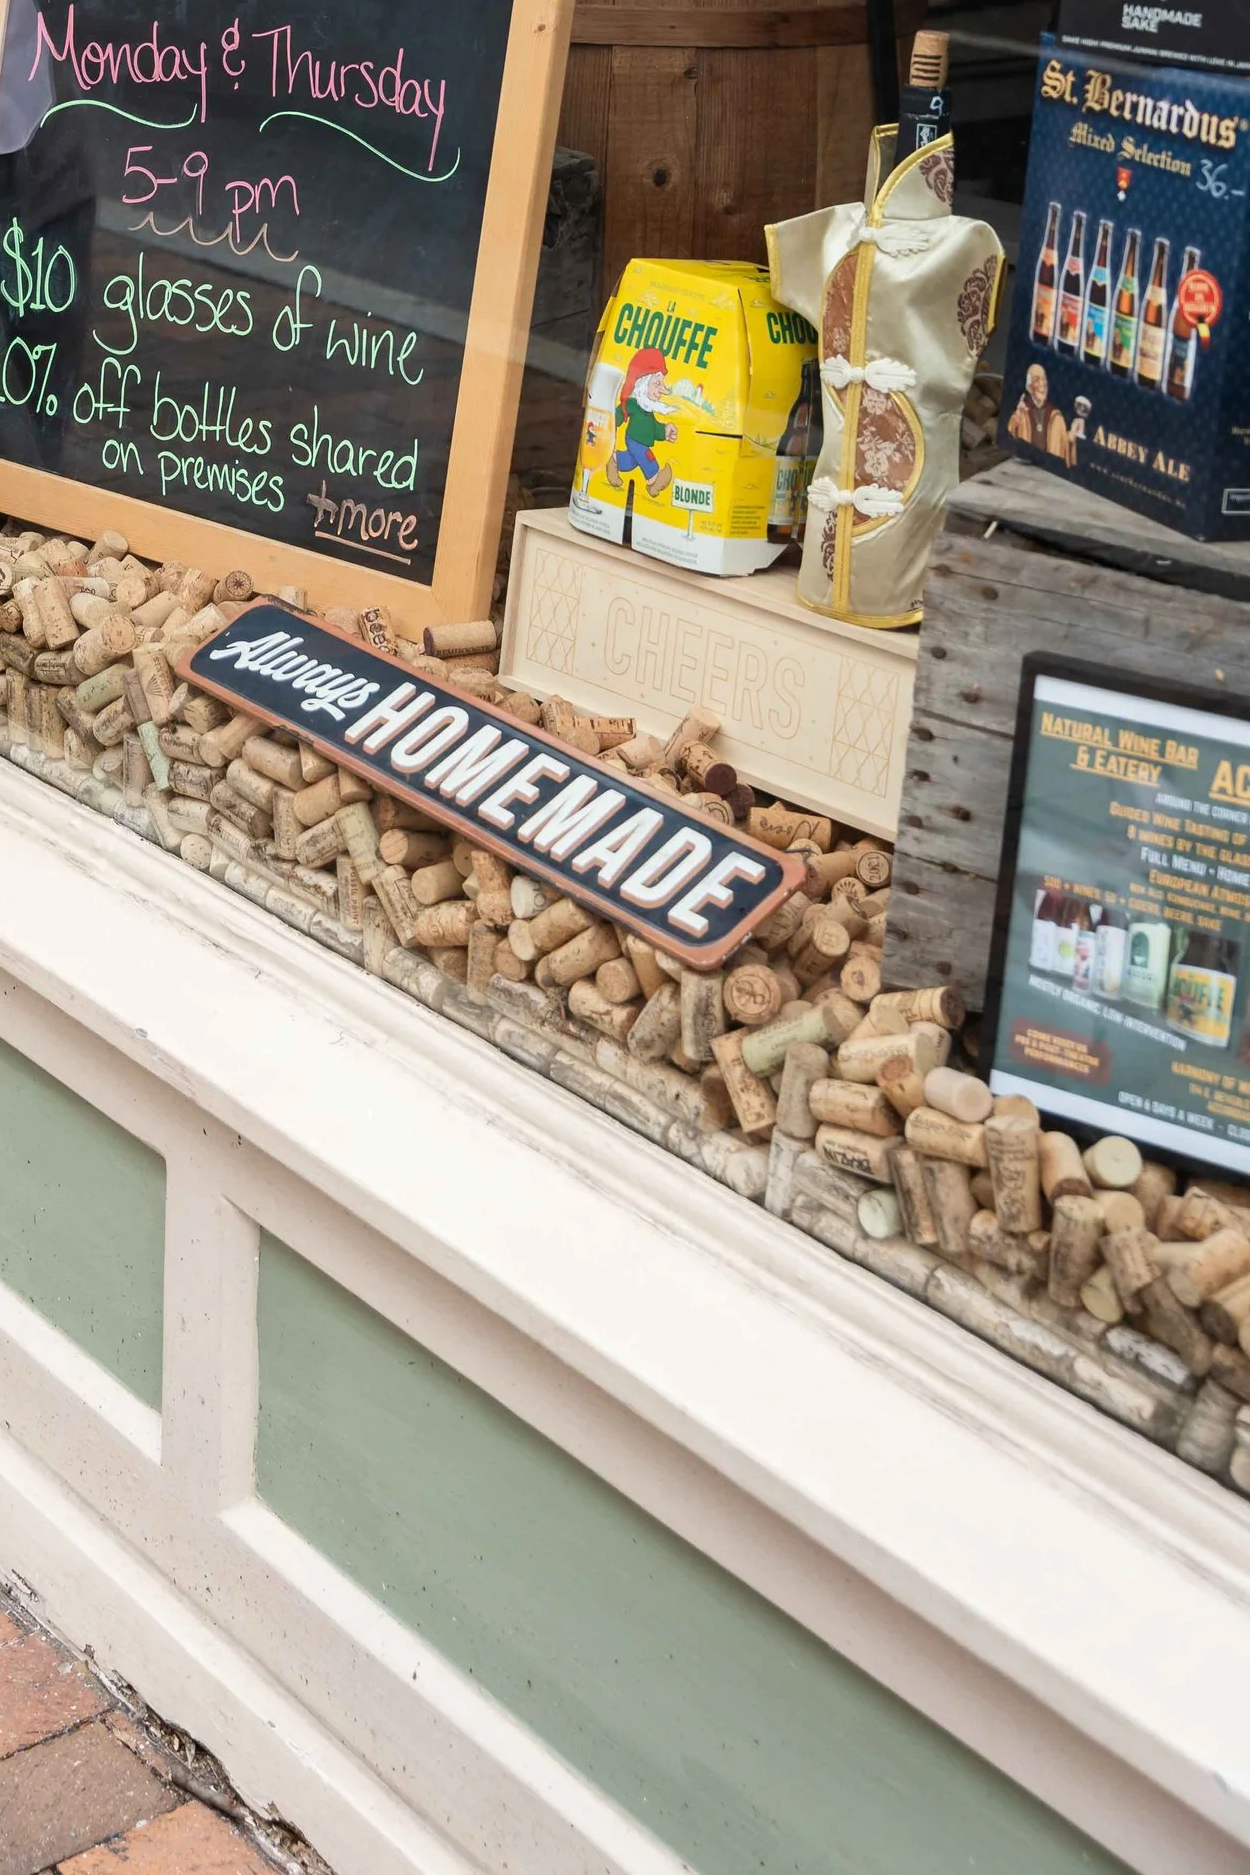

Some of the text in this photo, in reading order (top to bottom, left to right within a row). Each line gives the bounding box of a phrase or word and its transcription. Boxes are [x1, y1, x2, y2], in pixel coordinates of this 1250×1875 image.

[1121, 16, 1159, 33] SAKE
[1122, 3, 1203, 28] HANDMADE
[28, 4, 446, 172] Monday & Thursday
[1081, 68, 1237, 151] Bernardus
[1068, 121, 1193, 177] Mixed Selection
[122, 145, 301, 244] 5-9 pm
[0, 217, 425, 386] $10 glasses of wine
[666, 300, 677, 314] LA
[613, 302, 719, 370] CHOUFFE
[72, 356, 141, 429] off
[149, 370, 273, 456] bottles
[290, 405, 420, 492] shared
[102, 438, 285, 512] on premises
[1093, 425, 1190, 481] ABBEY ALE
[673, 483, 712, 507] BLONDE
[603, 596, 807, 740] CHEERS
[1040, 711, 1199, 765] NATURAL WINE BAR
[208, 630, 767, 937] Always HOMEMADE
[1093, 749, 1163, 784] EATERY
[1152, 809, 1181, 831] WINE
[1184, 818, 1230, 843] TASTING
[1193, 799, 1210, 817] THE
[1140, 845, 1169, 868] FULL
[1171, 853, 1208, 876] MENU
[1175, 836, 1192, 853] BY
[1194, 841, 1218, 861] THE
[1117, 1090, 1143, 1109] OPEN
[1151, 1099, 1177, 1120] DAYS
[1186, 1108, 1215, 1129] WEEK
